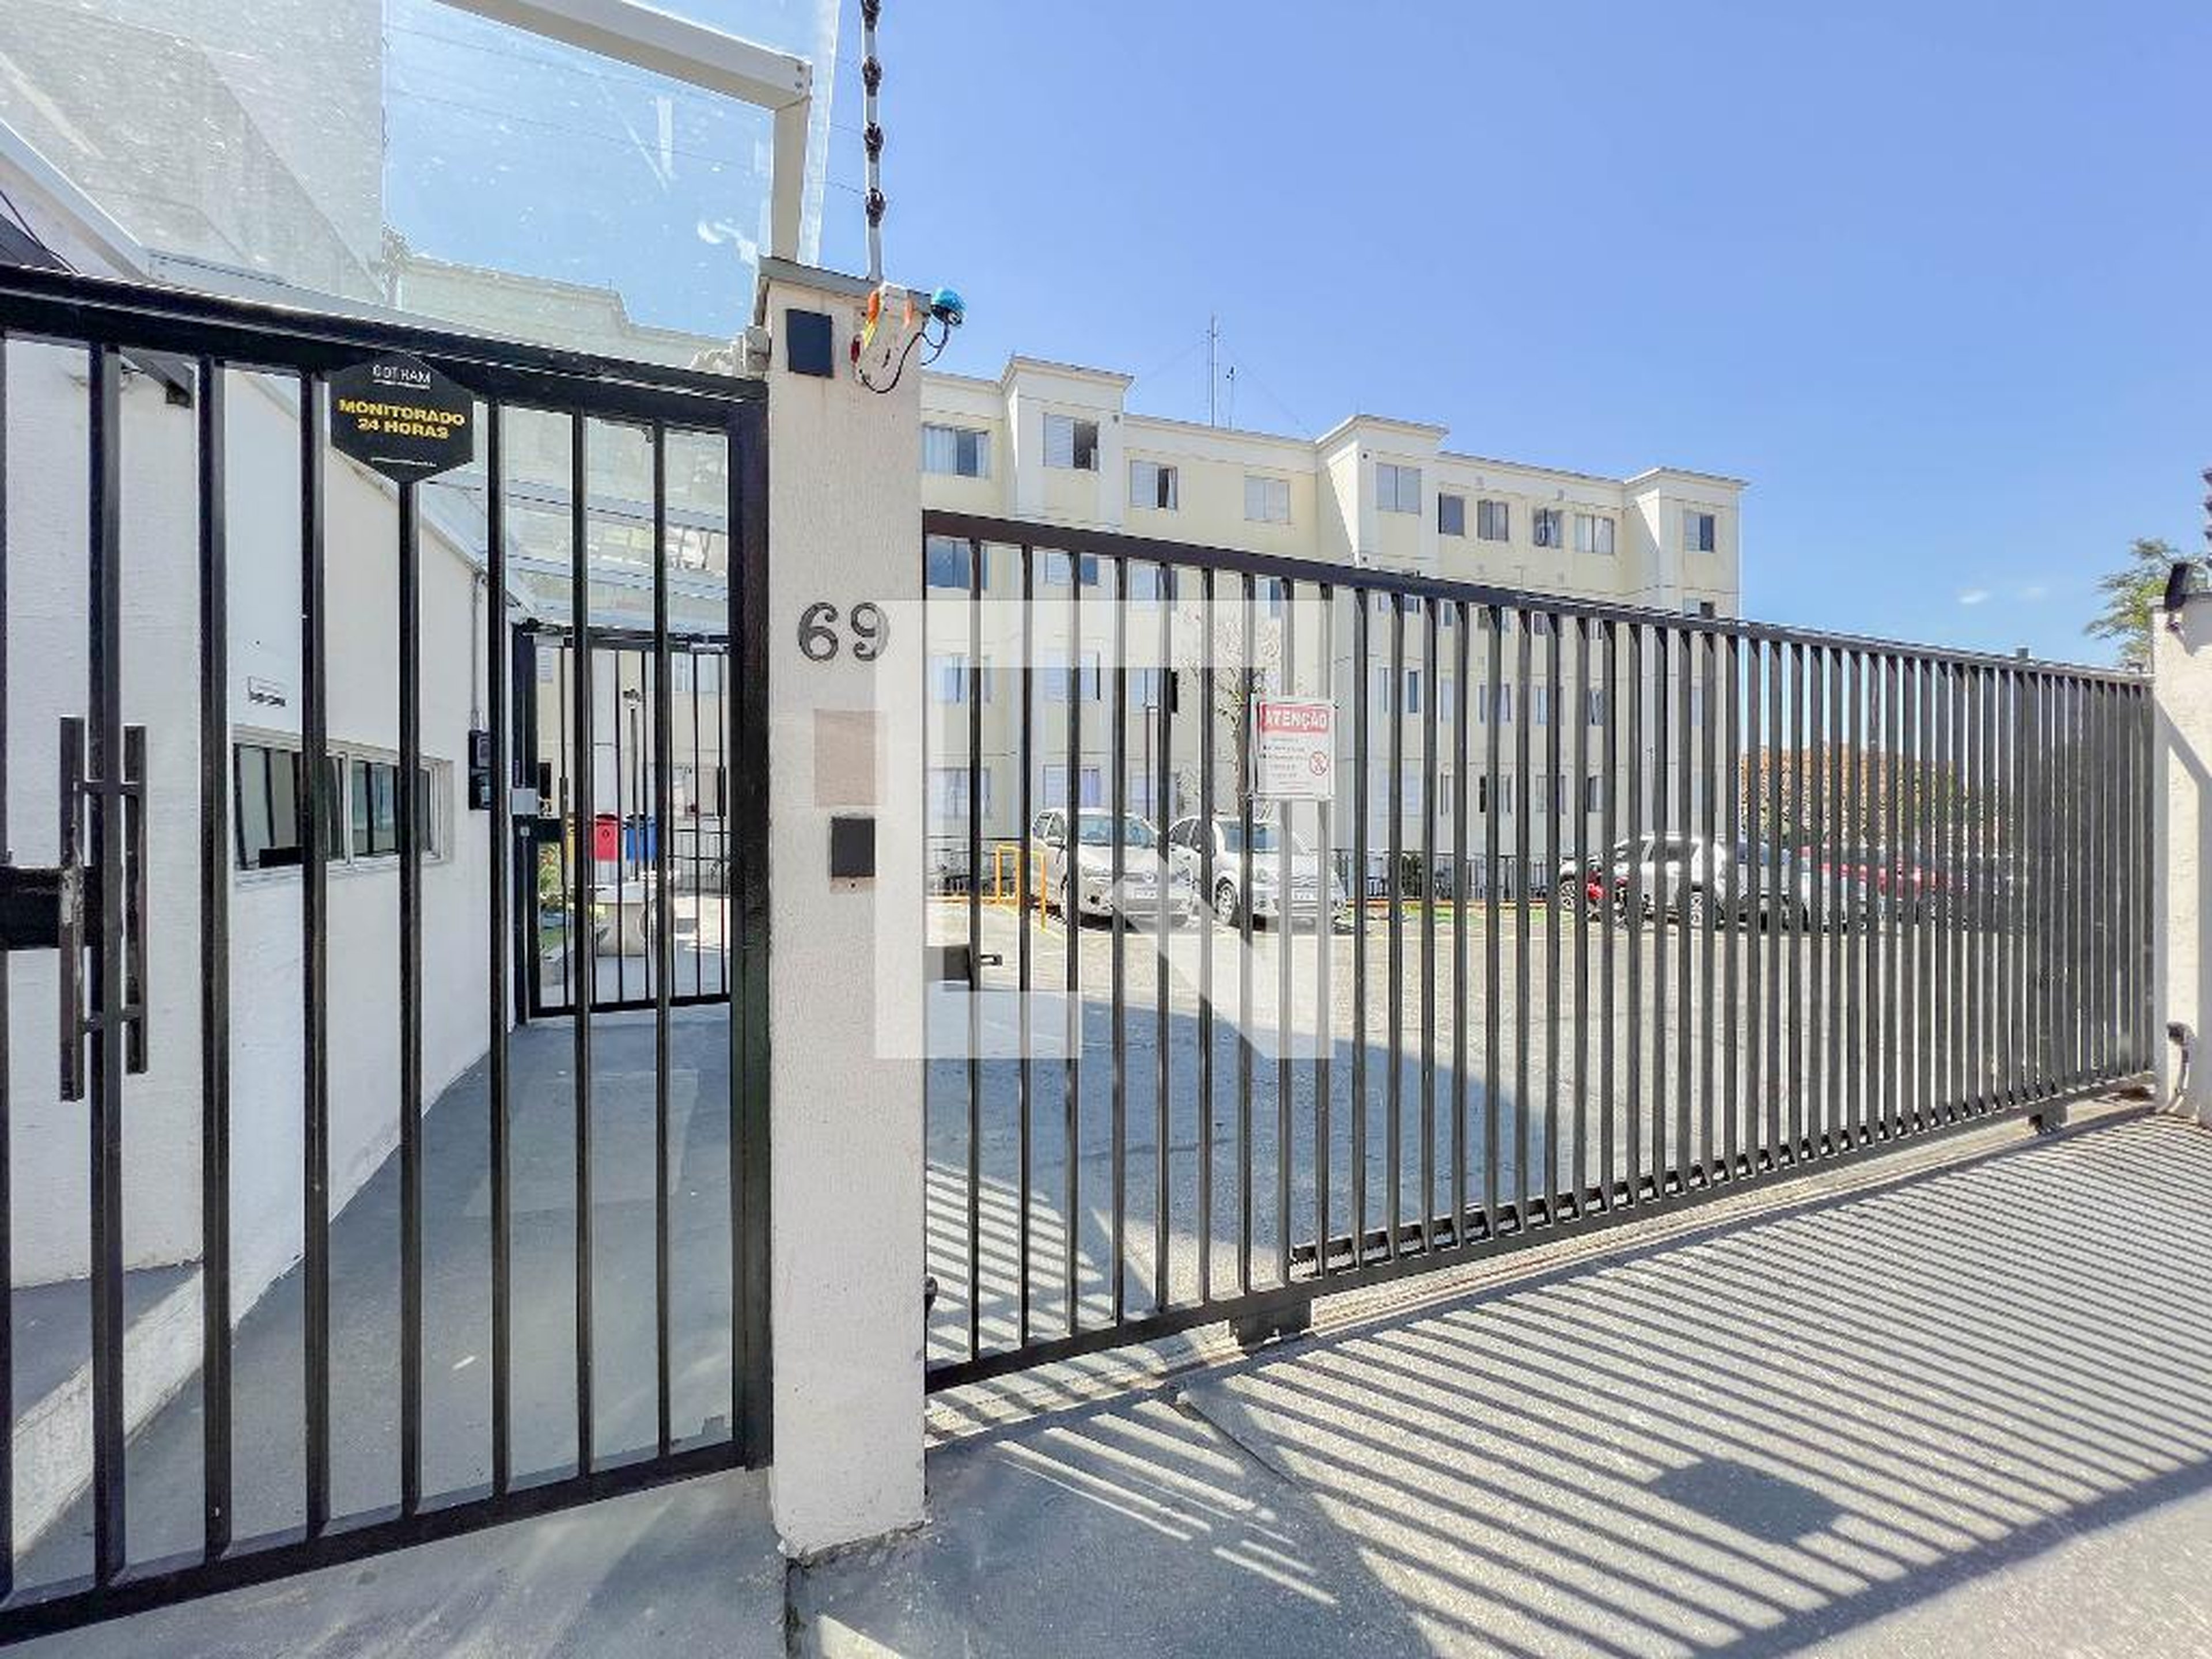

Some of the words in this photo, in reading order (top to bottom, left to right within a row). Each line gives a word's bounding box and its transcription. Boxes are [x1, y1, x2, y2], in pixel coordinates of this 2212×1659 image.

[338, 399, 465, 426] MONITORADO
[358, 418, 380, 431] 24
[384, 421, 449, 440] HORAS
[798, 602, 890, 661] 69
[1264, 709, 1328, 730] ATENÇÃO
